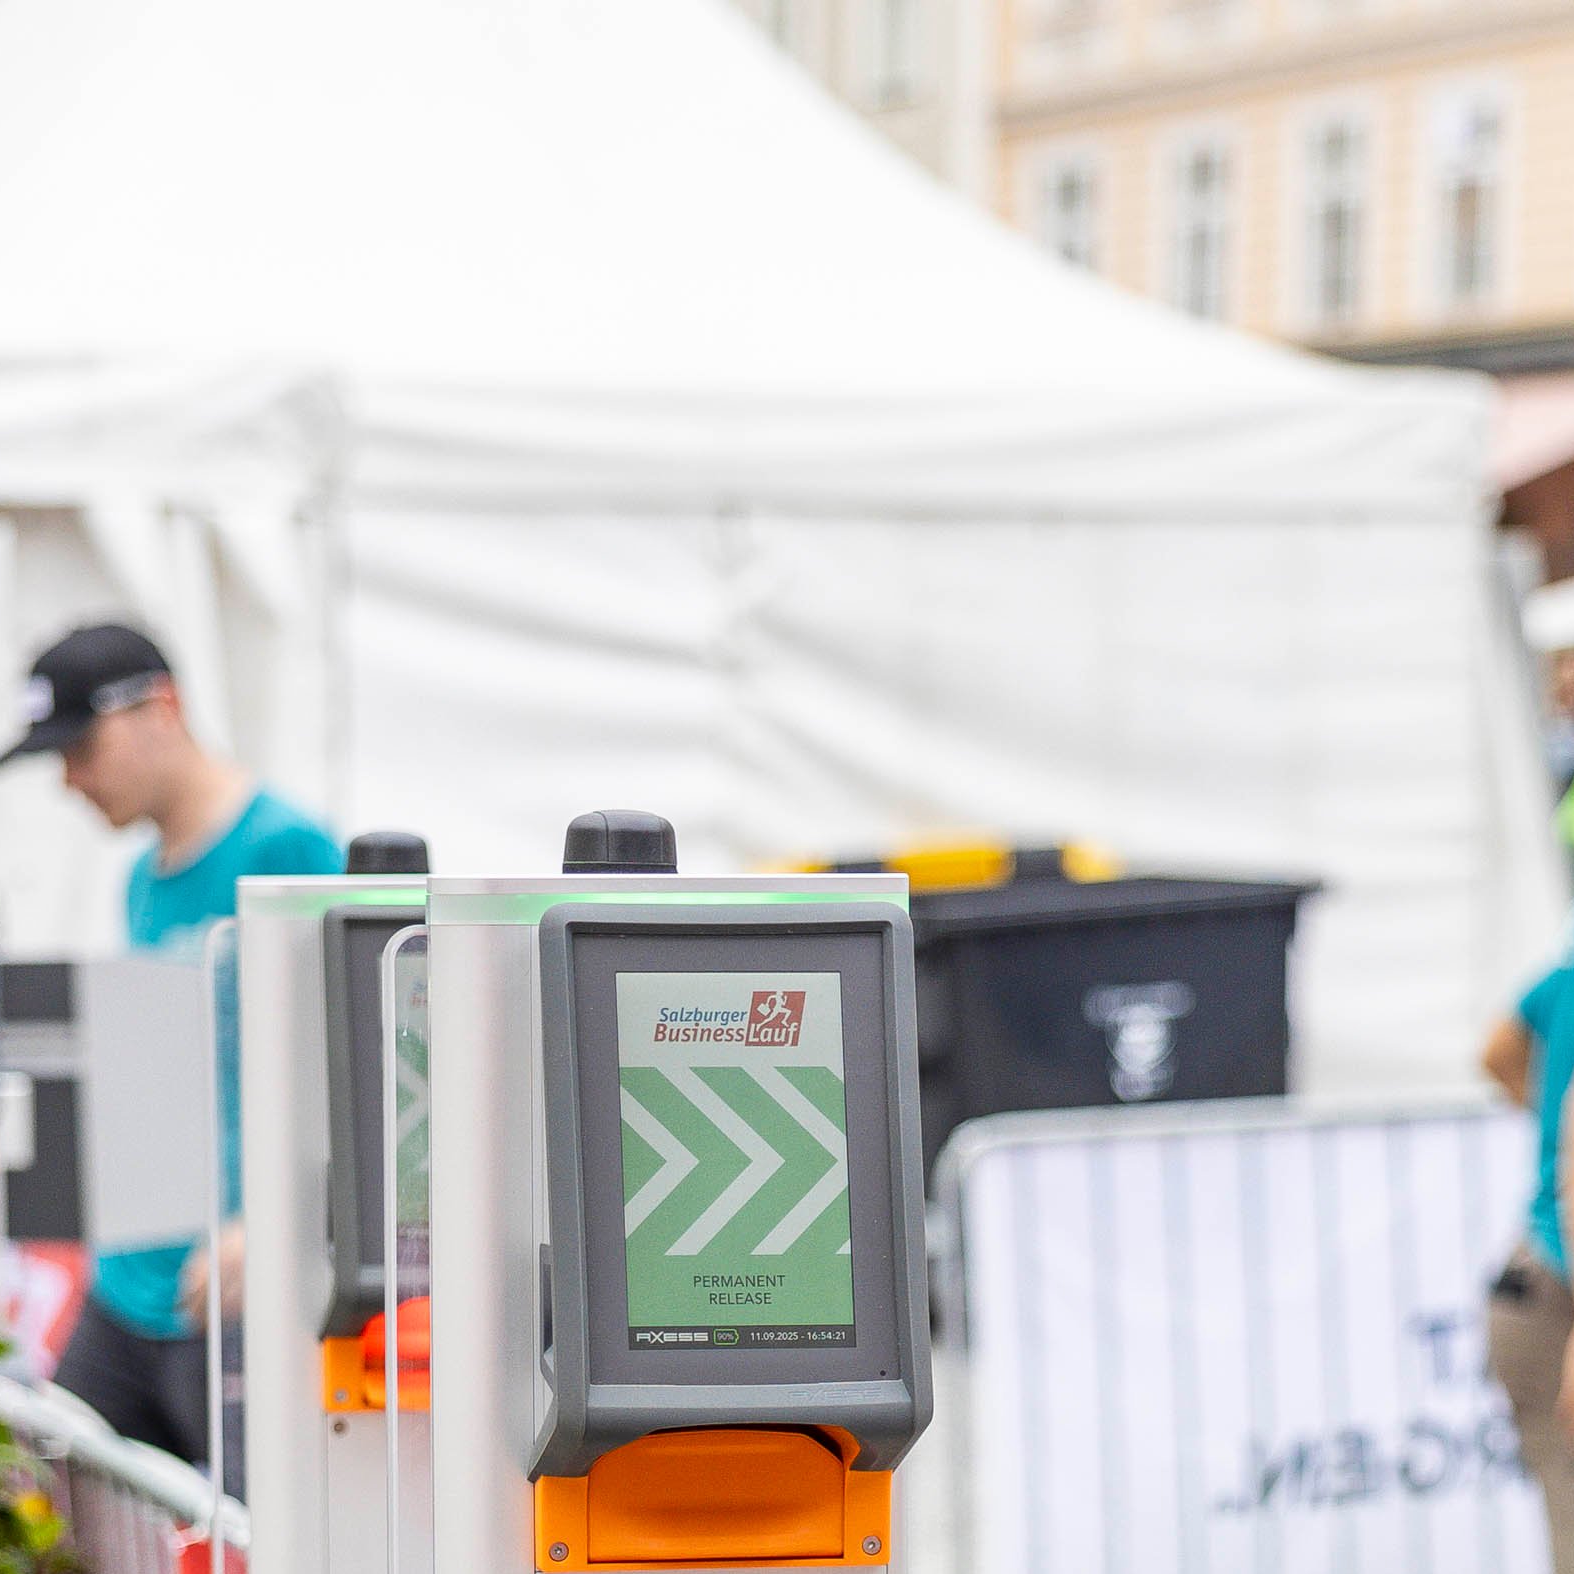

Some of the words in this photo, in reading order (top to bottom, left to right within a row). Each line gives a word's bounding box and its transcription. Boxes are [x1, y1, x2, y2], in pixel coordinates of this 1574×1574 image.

[658, 1007, 747, 1026] Salzburger
[693, 1275, 786, 1288] PERMANENT
[709, 1292, 773, 1305] RELEASE
[750, 1331, 799, 1342] 11.09.2025
[807, 1331, 846, 1341] 16:54:21
